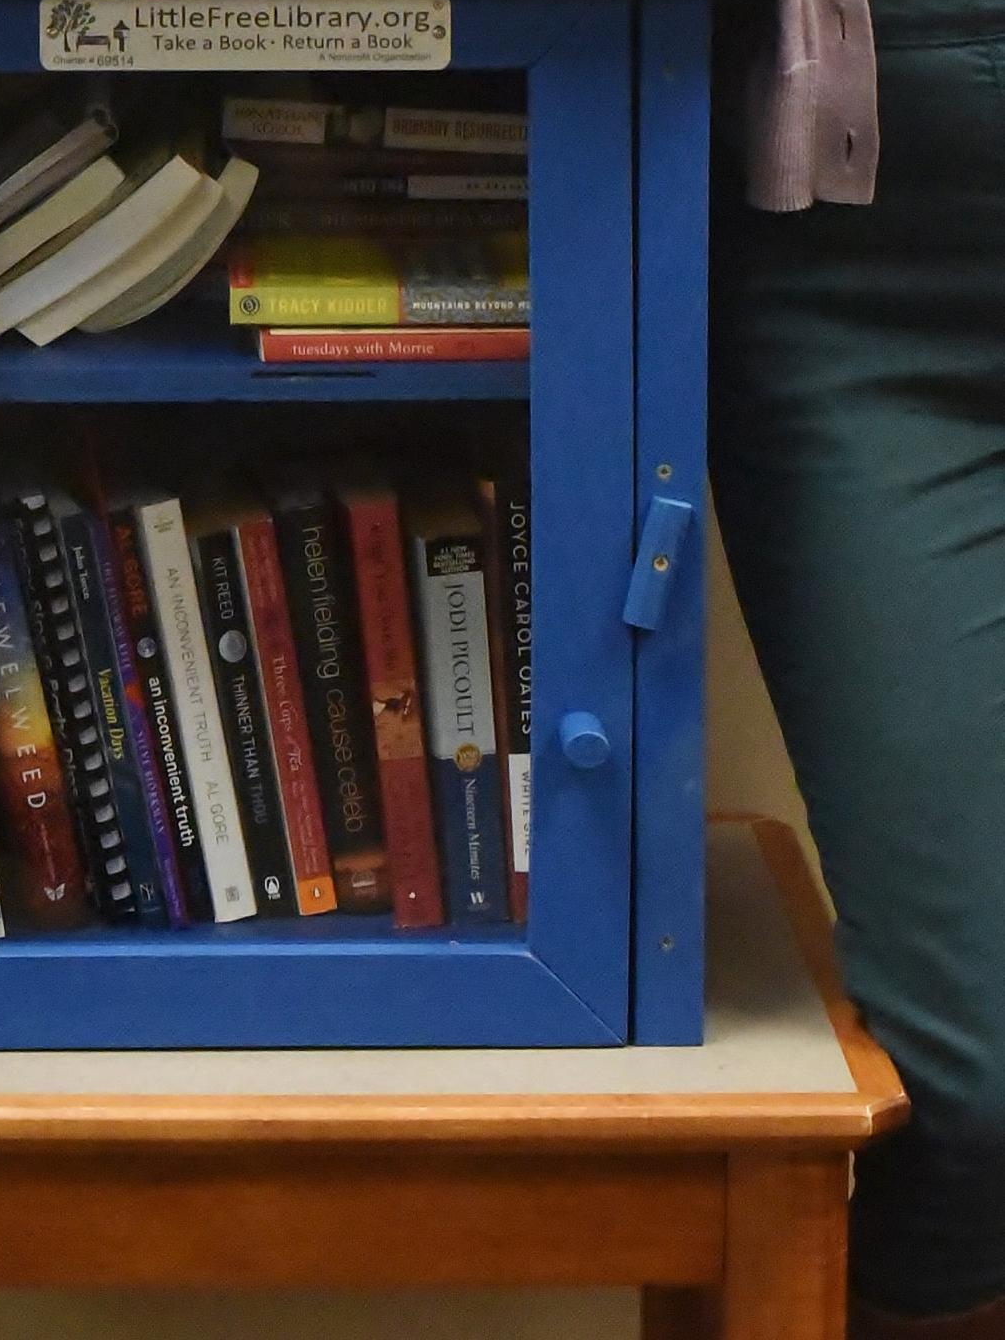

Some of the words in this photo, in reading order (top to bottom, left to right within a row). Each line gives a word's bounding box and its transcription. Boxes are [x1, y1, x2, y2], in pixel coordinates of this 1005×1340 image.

[134, 6, 430, 33] LittleFreeLibrary.org
[152, 35, 196, 51] Take
[202, 40, 212, 51] a
[219, 35, 267, 51] Book
[283, 35, 342, 50] Return
[351, 38, 361, 49] a
[367, 34, 413, 49] Book
[269, 297, 321, 315] TRACY
[327, 296, 388, 315] KIDDER
[292, 342, 351, 359] tuesdays
[355, 342, 384, 356] with
[388, 342, 435, 356] Morrie
[301, 526, 328, 595] helen
[510, 500, 528, 573] JOYCE
[166, 566, 183, 589] AN
[211, 556, 229, 579] KIT
[216, 581, 234, 620] REED
[445, 582, 465, 634] JODI
[514, 581, 532, 658] CAROL
[171, 592, 203, 705] INCONVENIENT
[98, 668, 119, 725] Vacation
[148, 676, 165, 697] an
[231, 674, 256, 737] THINNER
[451, 640, 474, 736] PICOULT
[192, 710, 213, 763] TRUTH
[273, 653, 286, 695] Three
[288, 745, 303, 772] Tea
[325, 688, 353, 762] cause
[107, 726, 124, 761] Days
[153, 697, 186, 804] inconvenient
[242, 739, 260, 779] THAN
[204, 780, 221, 802] AL
[337, 765, 369, 834] celeb
[463, 778, 478, 831] Nineteen
[174, 804, 196, 848] truth
[210, 802, 231, 846] GORE
[467, 833, 481, 880] Minutes
